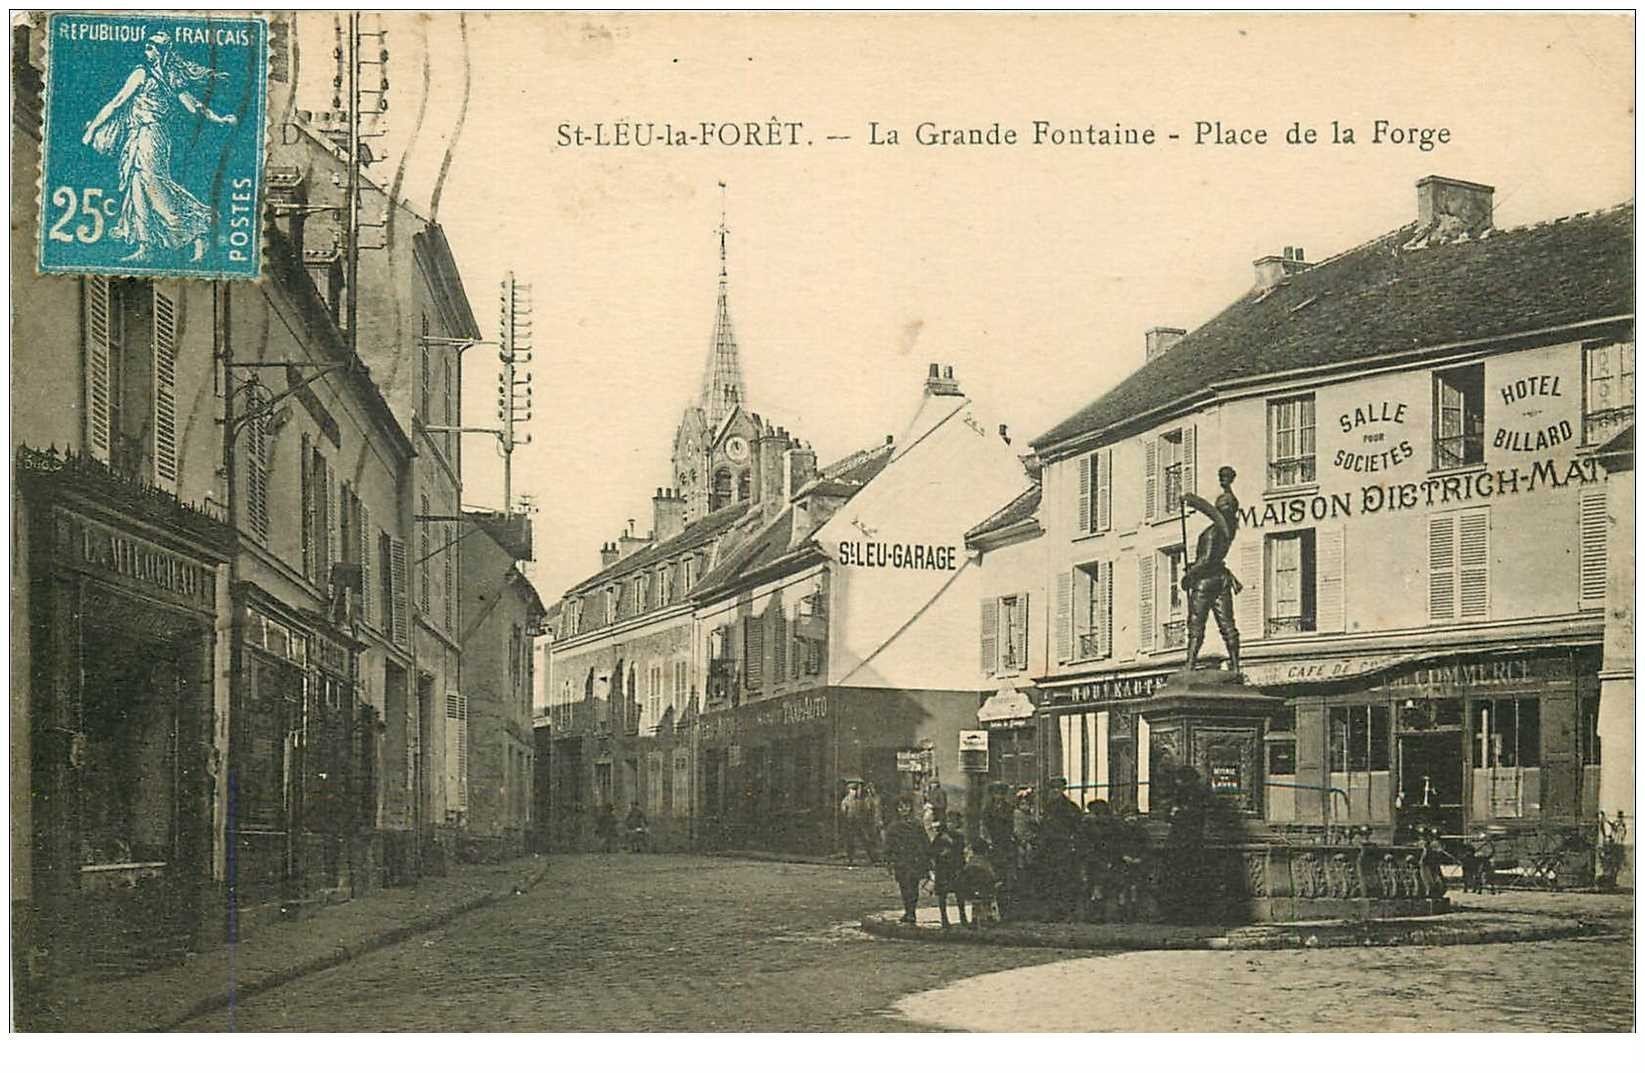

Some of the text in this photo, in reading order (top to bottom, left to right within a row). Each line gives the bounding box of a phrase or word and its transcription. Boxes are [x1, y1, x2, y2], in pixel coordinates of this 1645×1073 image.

[228, 177, 252, 262] POSTES
[1501, 375, 1562, 406] HOTEL
[1339, 401, 1408, 433] SALLE
[1493, 419, 1573, 452] BILLARD
[1334, 440, 1414, 473] SOCIETES
[1238, 492, 1353, 529] MAISON
